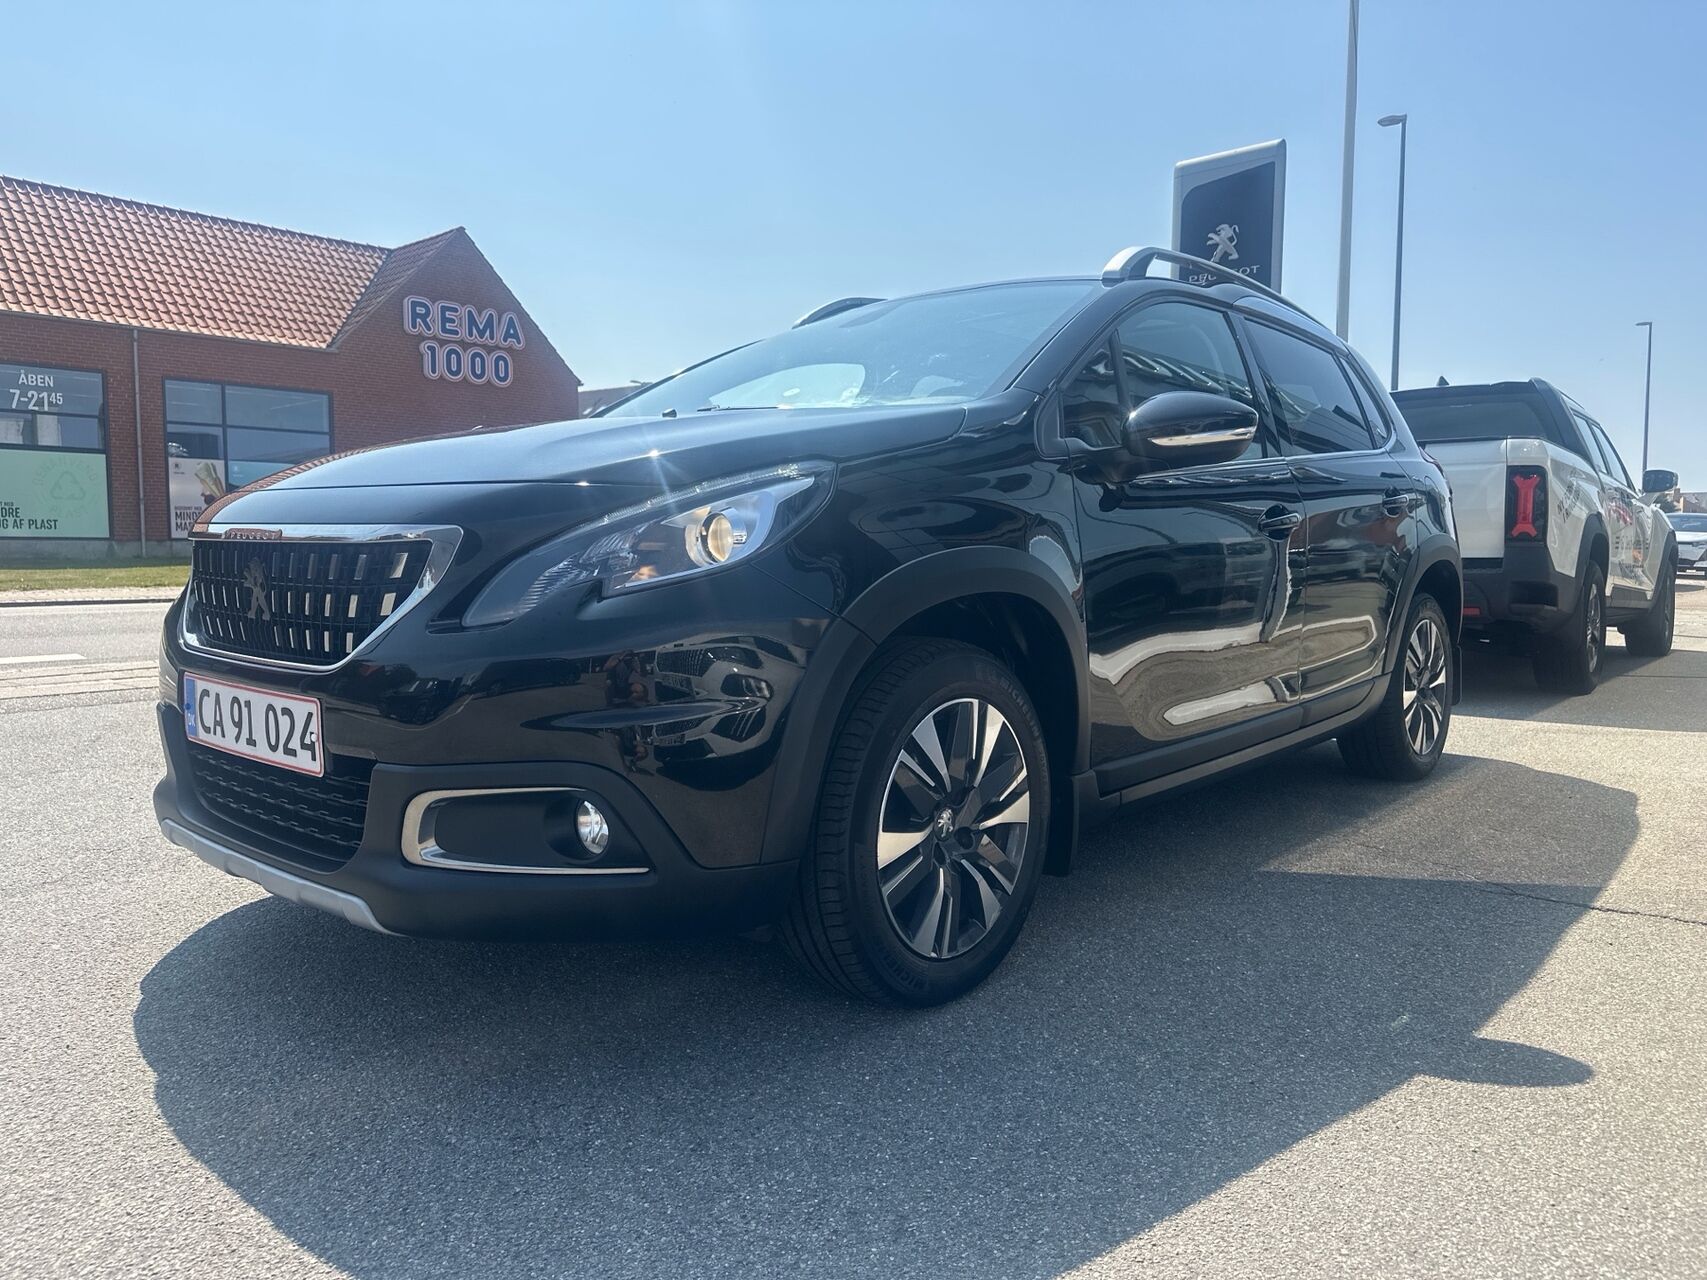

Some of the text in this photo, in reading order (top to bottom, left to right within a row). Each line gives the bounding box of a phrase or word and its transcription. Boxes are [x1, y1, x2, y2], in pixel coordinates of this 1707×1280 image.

[1188, 265, 1260, 283] PEUOT
[403, 295, 525, 350] REMA
[18, 369, 54, 387] ÅBEN
[419, 340, 513, 388] 1000
[12, 518, 25, 530] AF
[28, 518, 59, 530] PLAST
[230, 531, 276, 540] PEUGEOT
[999, 676, 1041, 737] MICHELIN
[198, 687, 317, 762] CA 91 024
